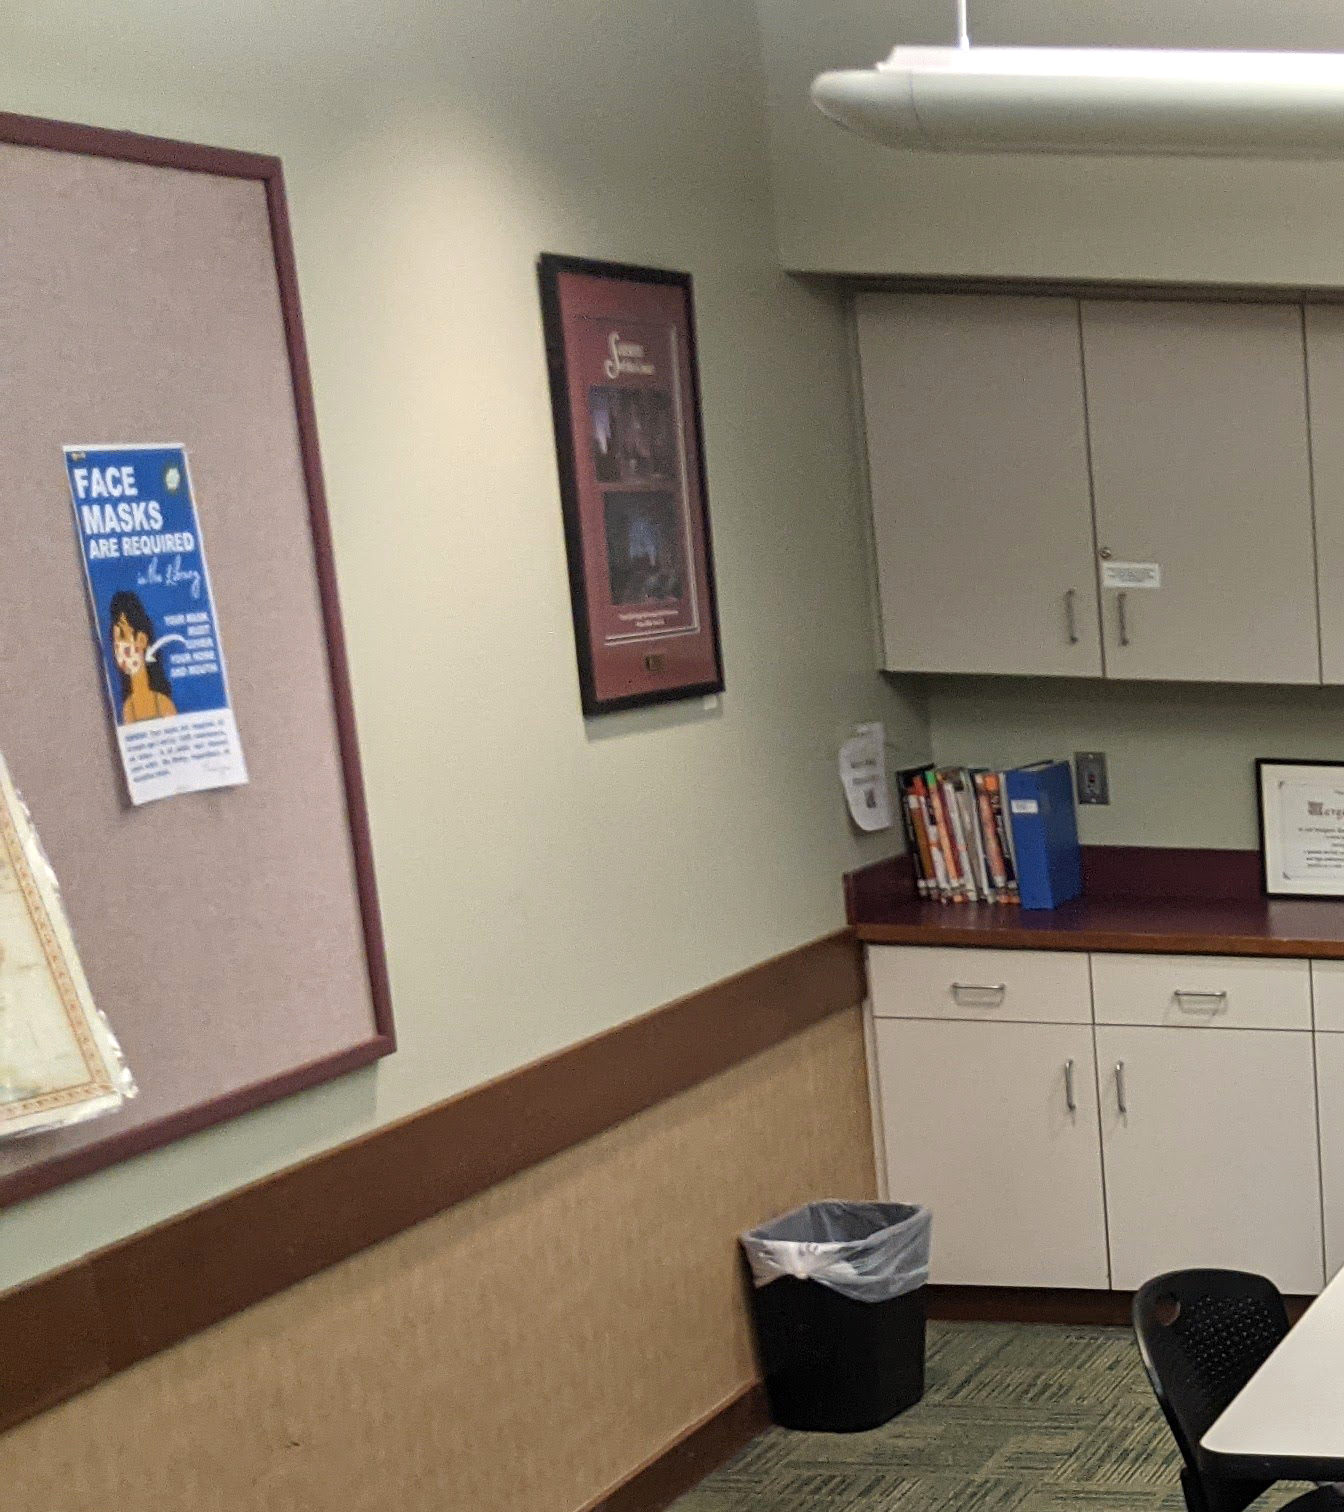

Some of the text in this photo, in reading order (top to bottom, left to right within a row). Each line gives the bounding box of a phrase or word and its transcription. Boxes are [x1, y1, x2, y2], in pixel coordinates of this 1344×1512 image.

[74, 466, 139, 499] FACE
[81, 501, 164, 535] MASKS
[89, 532, 196, 559] ARE REQUIRED
